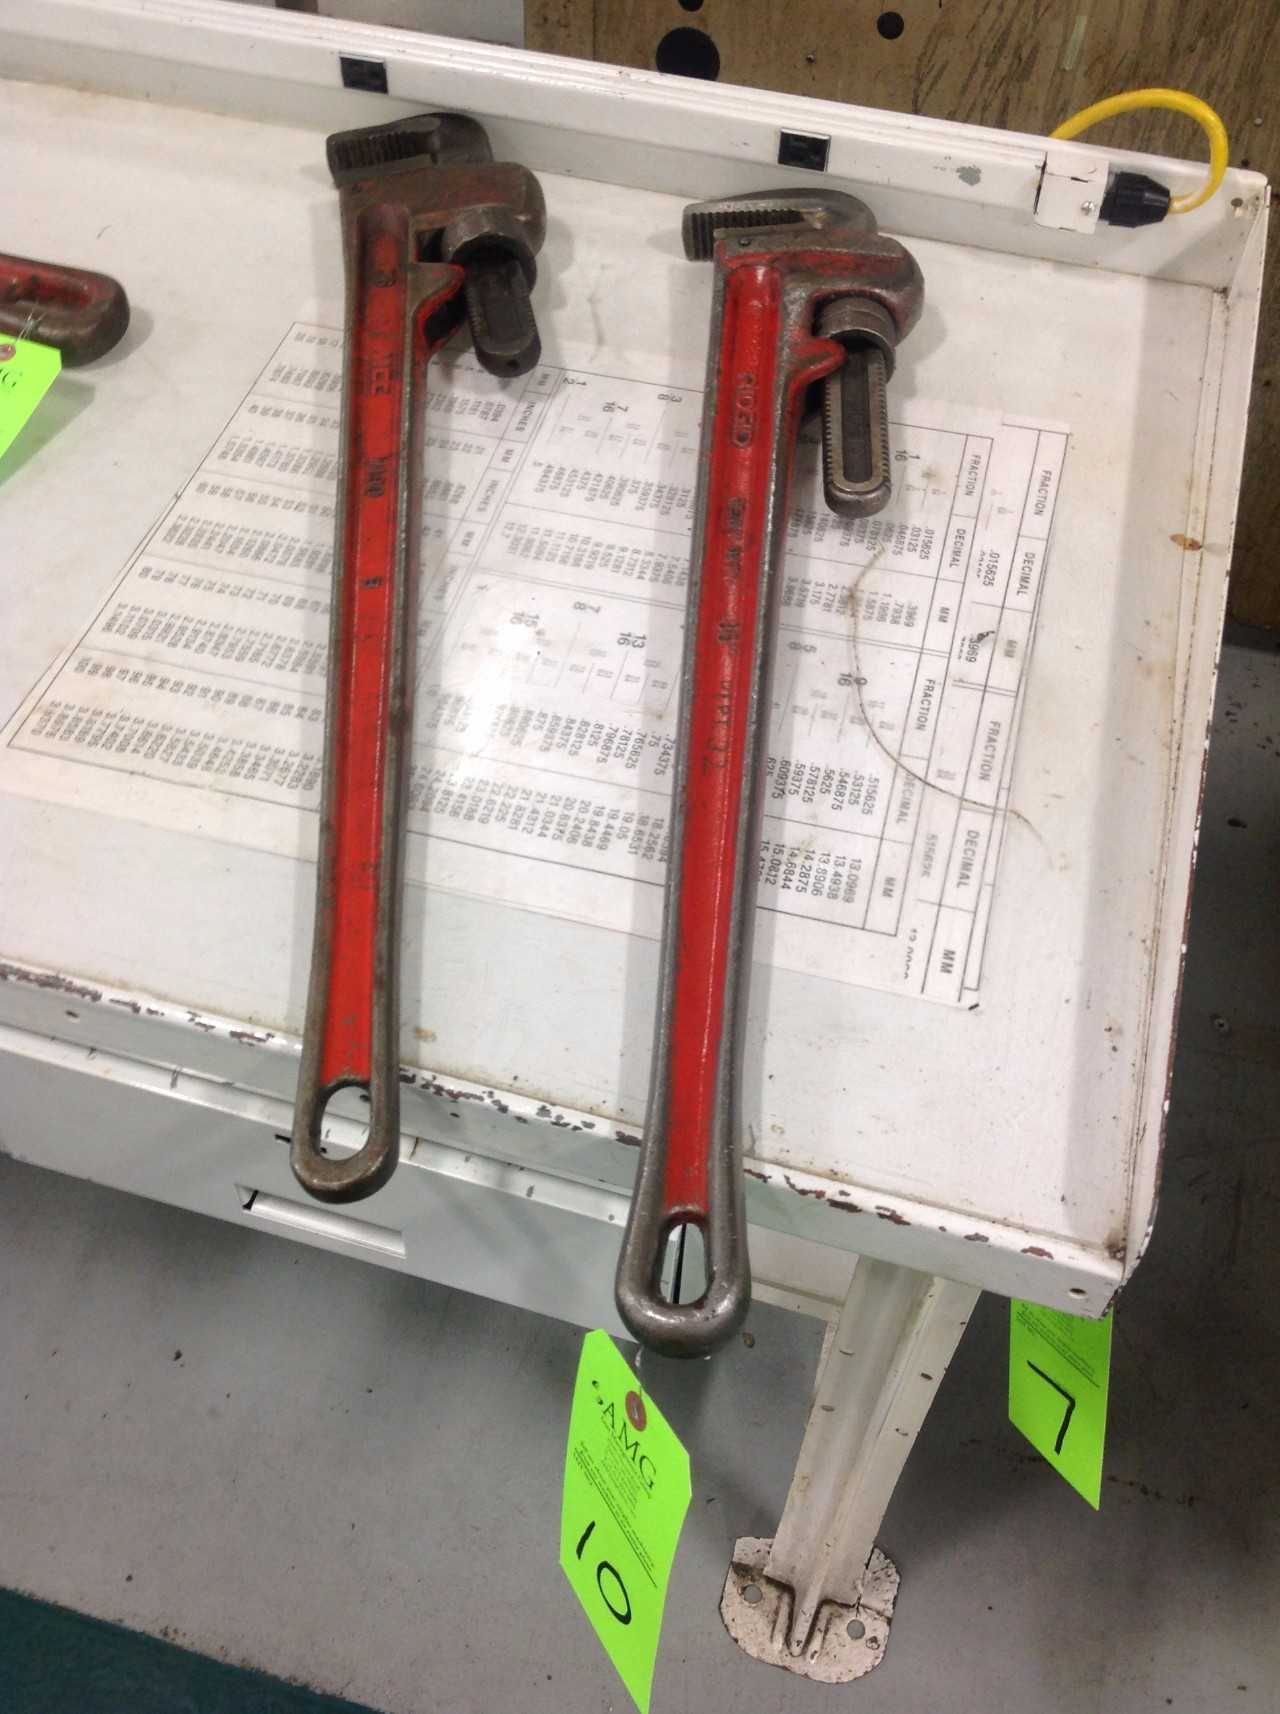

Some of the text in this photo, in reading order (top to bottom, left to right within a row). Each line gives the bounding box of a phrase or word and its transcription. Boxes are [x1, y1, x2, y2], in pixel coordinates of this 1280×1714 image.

[515, 401, 537, 433] INCHES
[982, 549, 1000, 588] .015625
[617, 631, 632, 646] 16
[631, 634, 647, 648] 13
[837, 673, 853, 687] 16
[882, 454, 982, 898] FRACTION DECIMAL MM FRACTION DECIMAL MM
[585, 720, 605, 747] .8125
[594, 722, 618, 764] .796875
[611, 725, 633, 759] .78125
[645, 730, 663, 748] .75
[939, 470, 1052, 975] FRACTION DECIMAL MM FRACTION DECIMAL MM
[623, 728, 648, 769] .765625
[652, 732, 676, 776] .734375
[771, 755, 793, 800] .609375
[787, 759, 807, 796] .59375
[800, 761, 822, 803] .578125
[830, 767, 852, 811] .546875
[846, 769, 866, 806] .53125
[860, 771, 881, 815] .515625
[520, 790, 547, 835] 21.4312
[536, 793, 562, 839] 21.0344
[615, 810, 635, 840] 19.05
[763, 842, 785, 886] 15.0812
[779, 845, 800, 890] 14.6844
[794, 848, 815, 894] 14.2875
[809, 851, 831, 897] 13.8906
[824, 854, 847, 901] 13.4938
[1027, 1359, 1076, 1456] 7
[603, 1402, 657, 1490] AMG
[576, 1520, 632, 1626] 10
